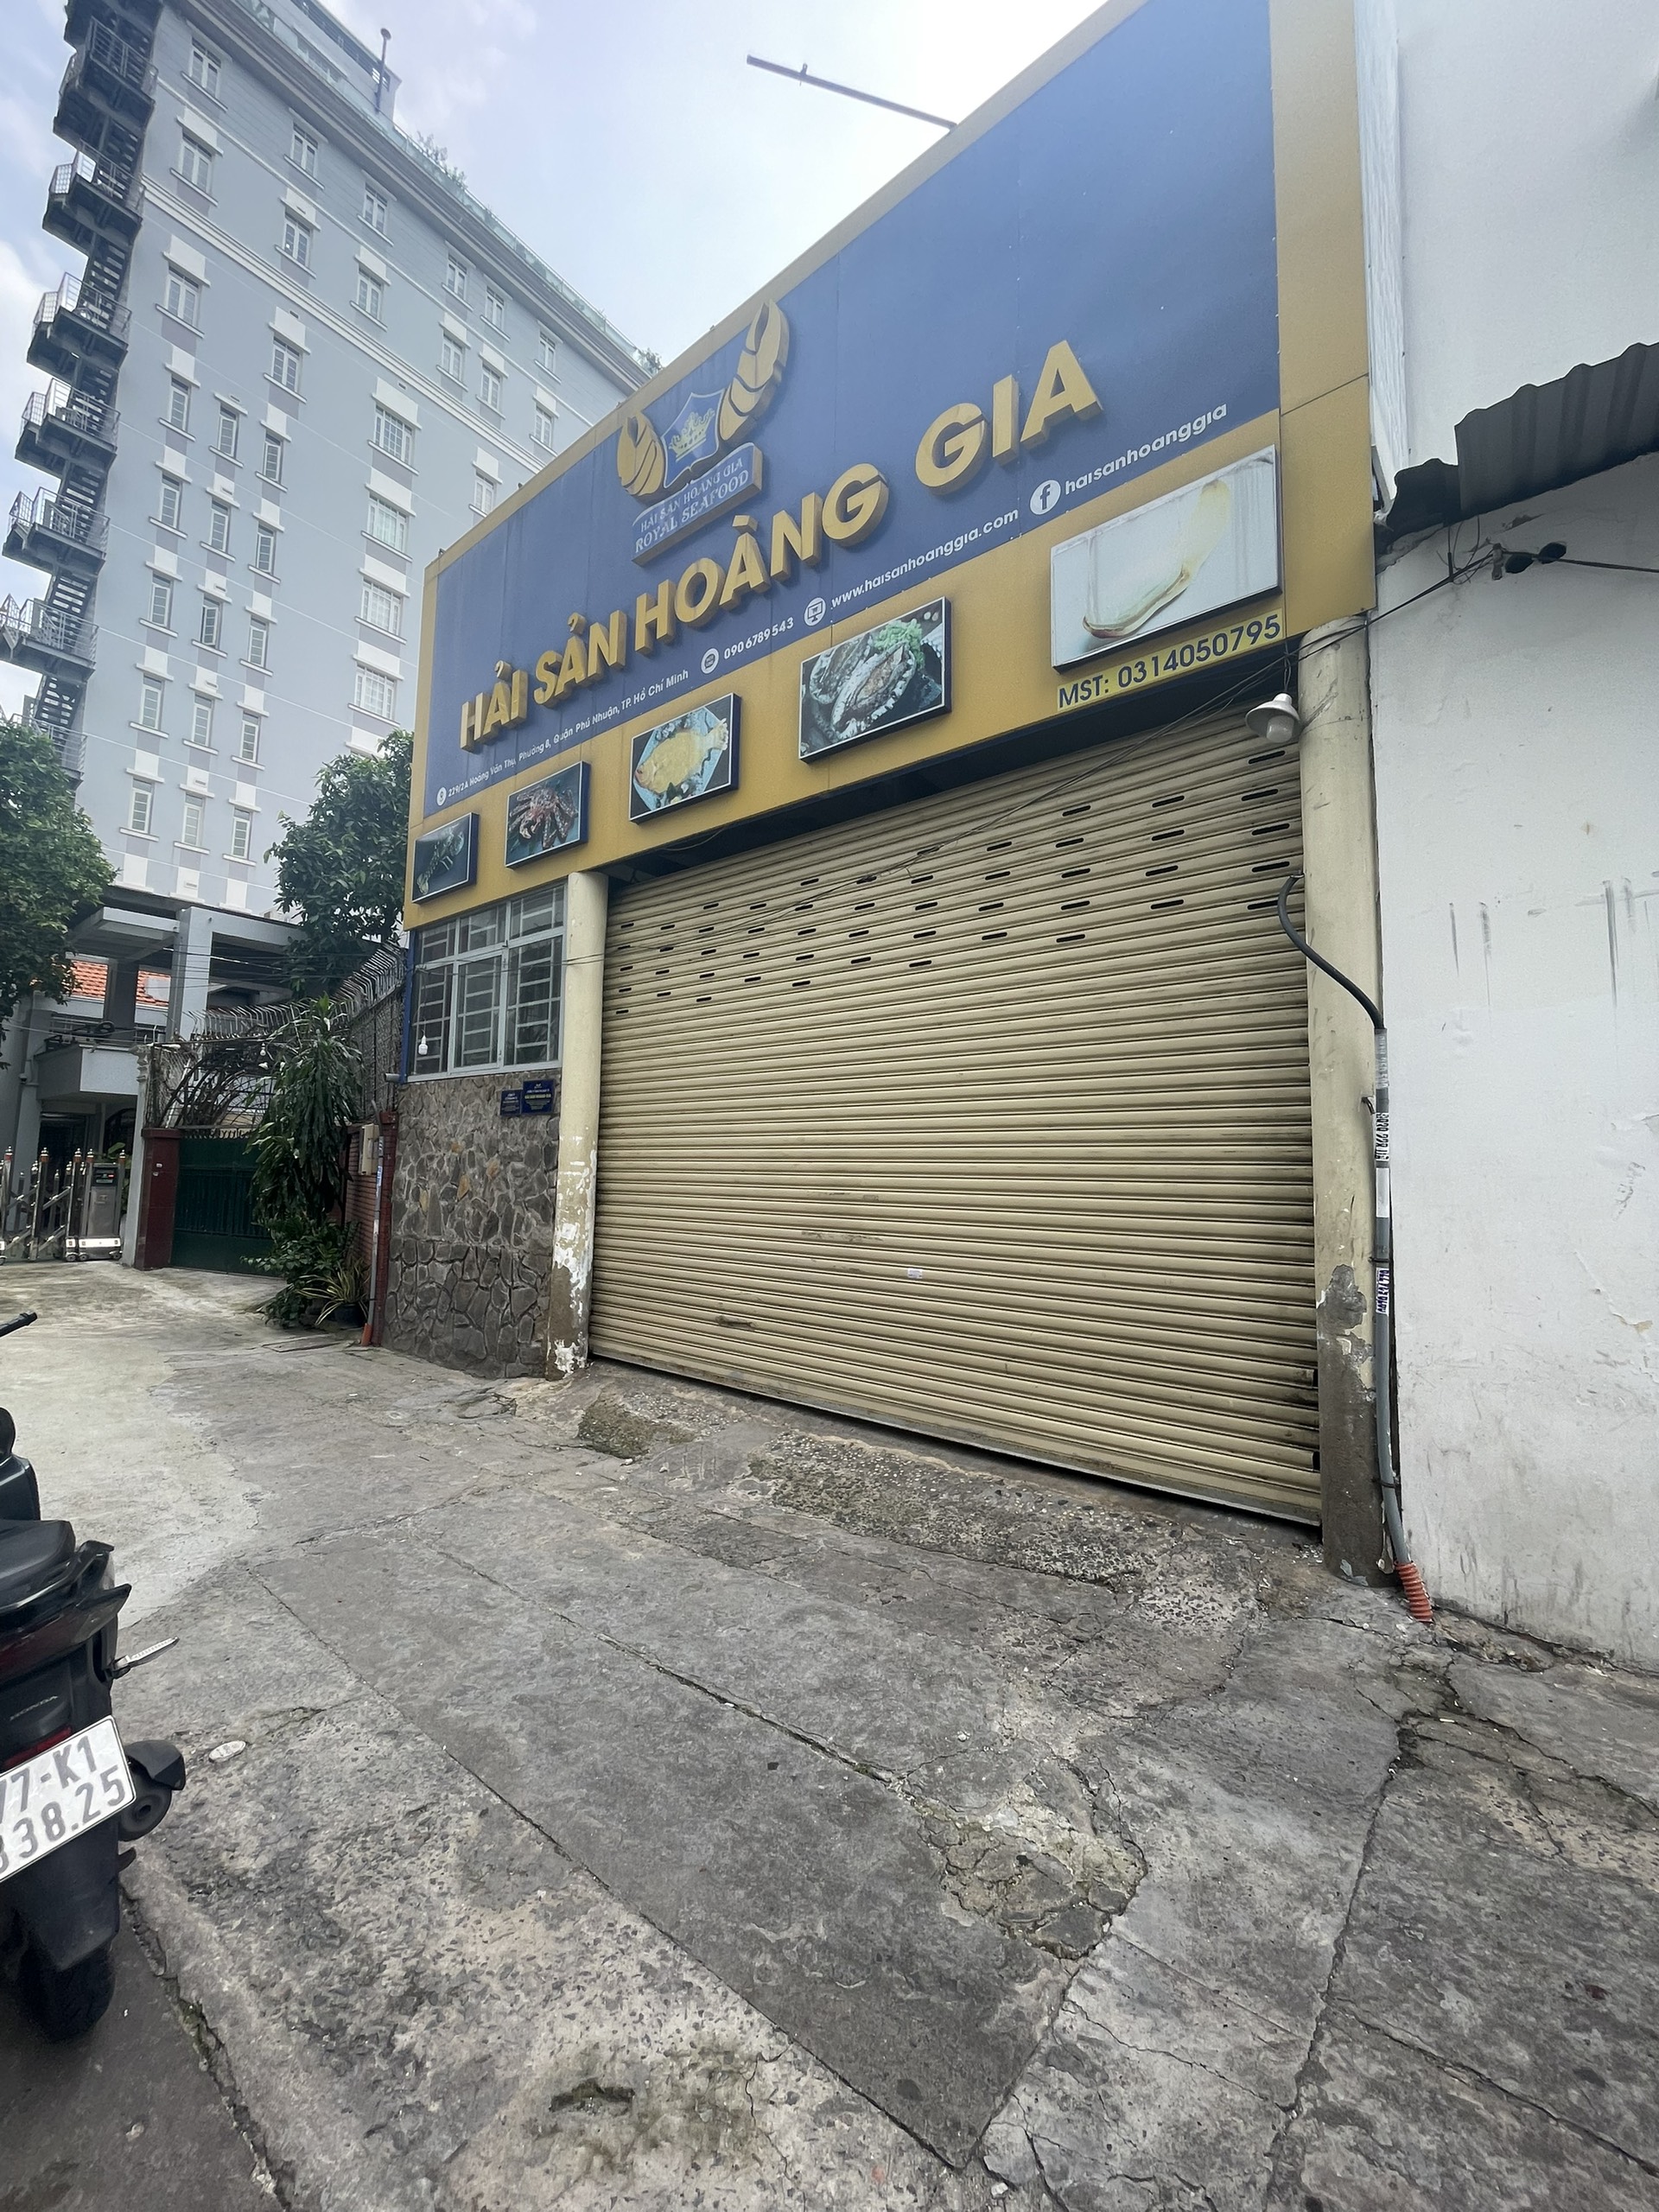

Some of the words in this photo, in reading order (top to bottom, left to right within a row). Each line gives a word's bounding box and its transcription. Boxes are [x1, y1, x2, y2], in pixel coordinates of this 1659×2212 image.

[723, 457, 743, 477] GIA
[1065, 403, 1228, 495] haisanhoanggia
[461, 660, 528, 751] HẢI
[534, 611, 627, 706] SẢN
[635, 463, 889, 654] HOÀNG
[915, 340, 1103, 495] GIA
[635, 517, 677, 553] ROYAL
[682, 469, 749, 524] SEAFOOD
[831, 509, 1019, 609] www.haisanhoanggia.com
[575, 715, 590, 734] Phú
[592, 705, 620, 725] Nhuận,
[621, 697, 632, 710] TP.
[633, 687, 646, 706] Hồ
[648, 678, 664, 696] Chí
[665, 669, 689, 690] Minh
[1058, 675, 1109, 709] MST:
[1117, 613, 1281, 689] 0314050795
